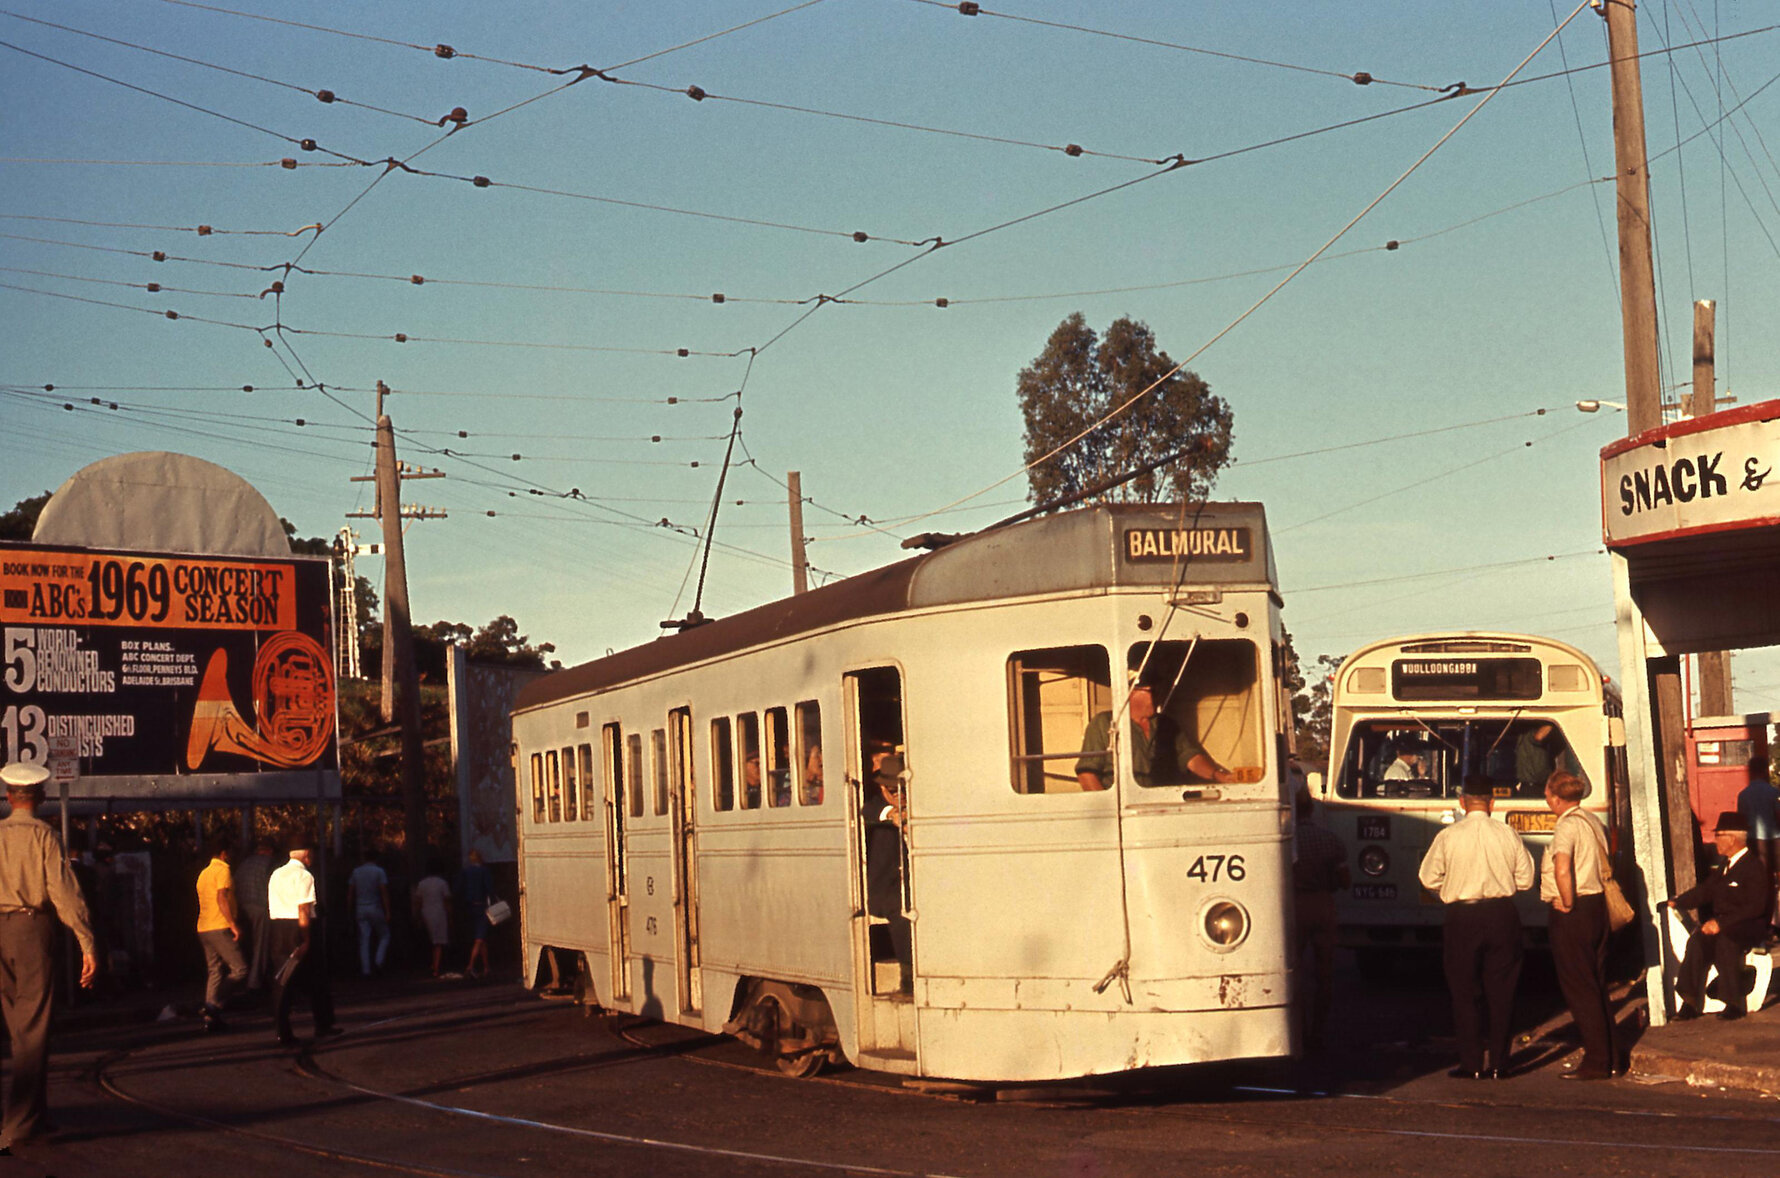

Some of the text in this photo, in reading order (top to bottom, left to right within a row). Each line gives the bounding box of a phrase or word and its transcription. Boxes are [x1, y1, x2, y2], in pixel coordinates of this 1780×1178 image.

[1620, 451, 1772, 516] SNACK &
[1130, 530, 1244, 556] BALMORAL
[3, 562, 84, 579] BOOK NOW FOR THE
[174, 565, 284, 599] CONCERT
[88, 560, 170, 622] 1969
[185, 594, 278, 625] SEASON
[121, 641, 139, 650] BOX
[4, 627, 36, 694] 5
[37, 649, 98, 672] RENOWNED
[122, 653, 139, 661] ABC
[140, 653, 174, 662] CONCERT
[1402, 663, 1478, 674] WOOLLOONGABBA
[37, 670, 116, 693] CONDUCTORS
[122, 676, 153, 685] ADELAIDE
[1, 704, 48, 766] 13
[48, 715, 134, 737] DISTINGUISHED
[56, 739, 70, 747] NO
[1187, 854, 1246, 882] 476
